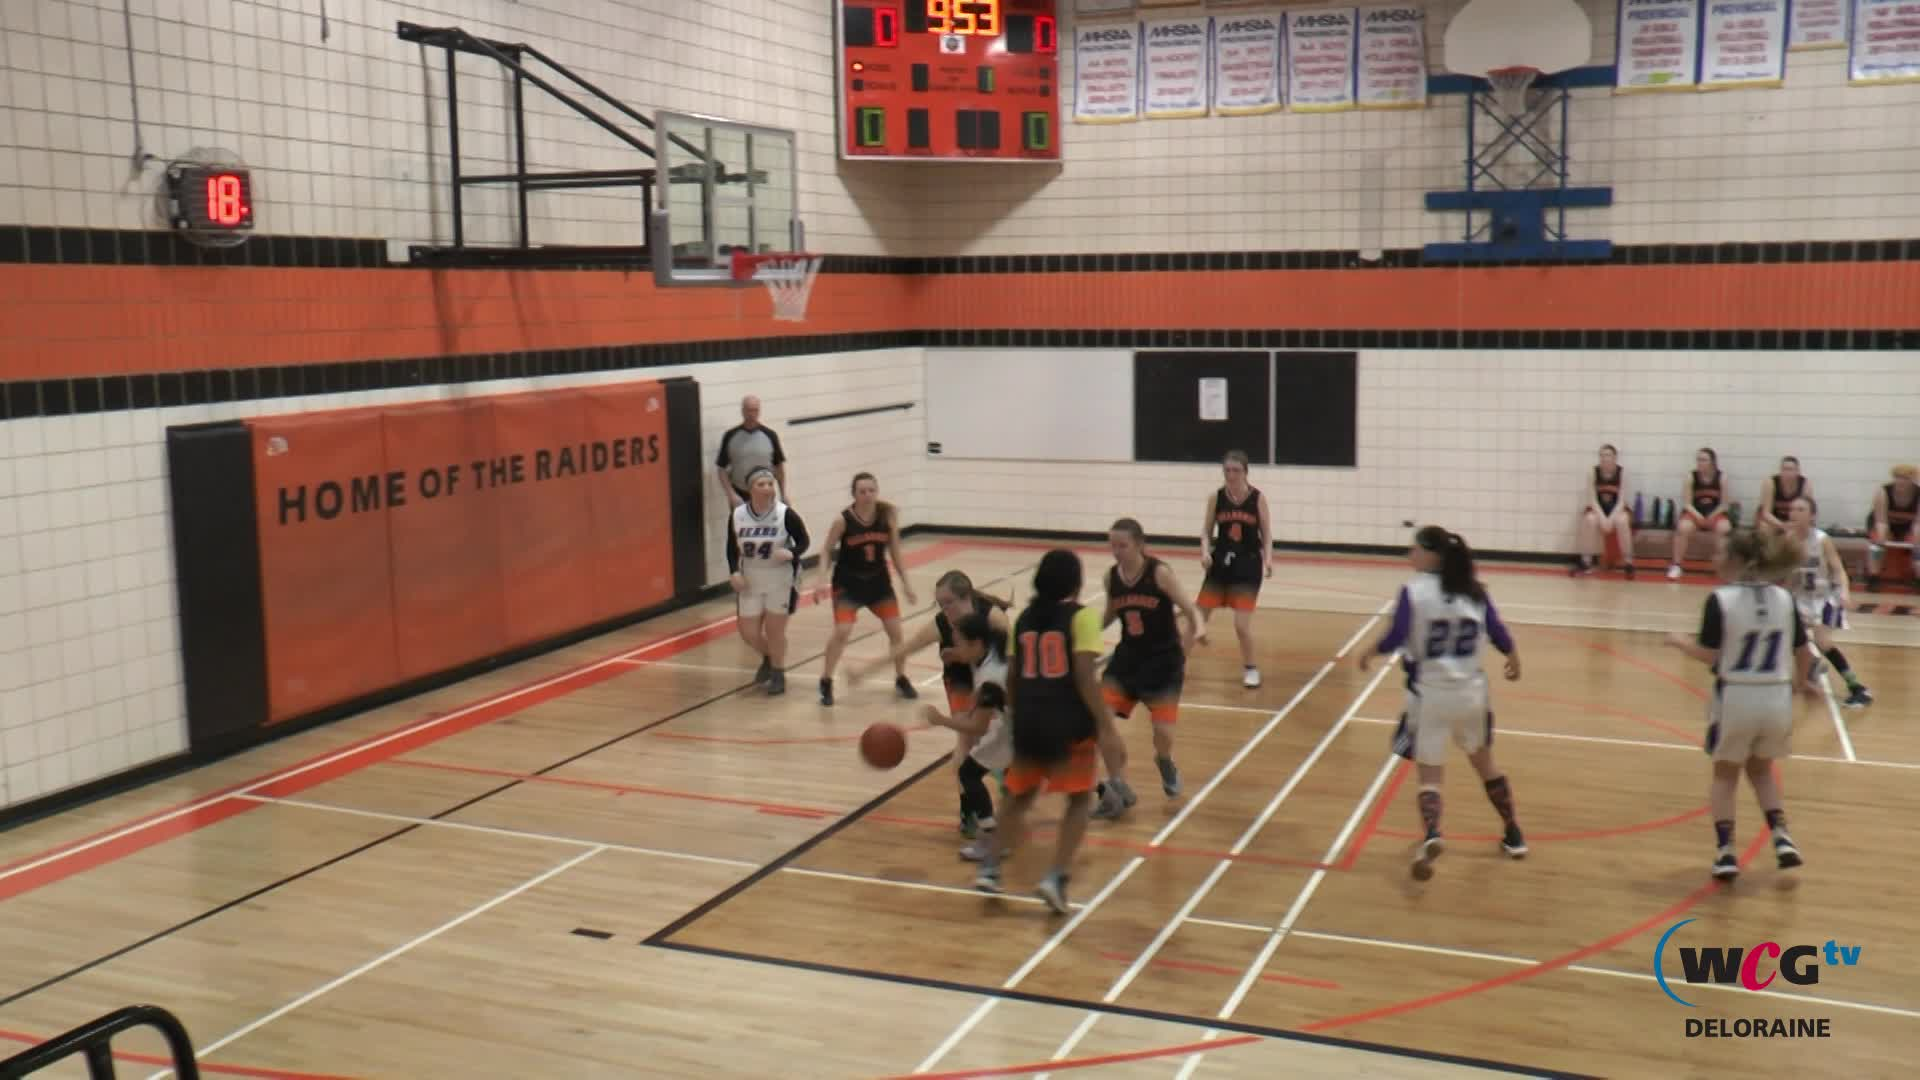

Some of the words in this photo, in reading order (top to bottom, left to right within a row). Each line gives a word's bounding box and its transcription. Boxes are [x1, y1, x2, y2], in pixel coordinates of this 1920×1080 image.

[278, 471, 406, 526] HOME
[418, 465, 460, 499] OF
[472, 454, 525, 490] THE
[535, 434, 660, 481] RAIDERS
[742, 541, 774, 560] 24
[1018, 631, 1069, 678] 10
[1427, 618, 1479, 658] 22
[1730, 630, 1784, 672] 11
